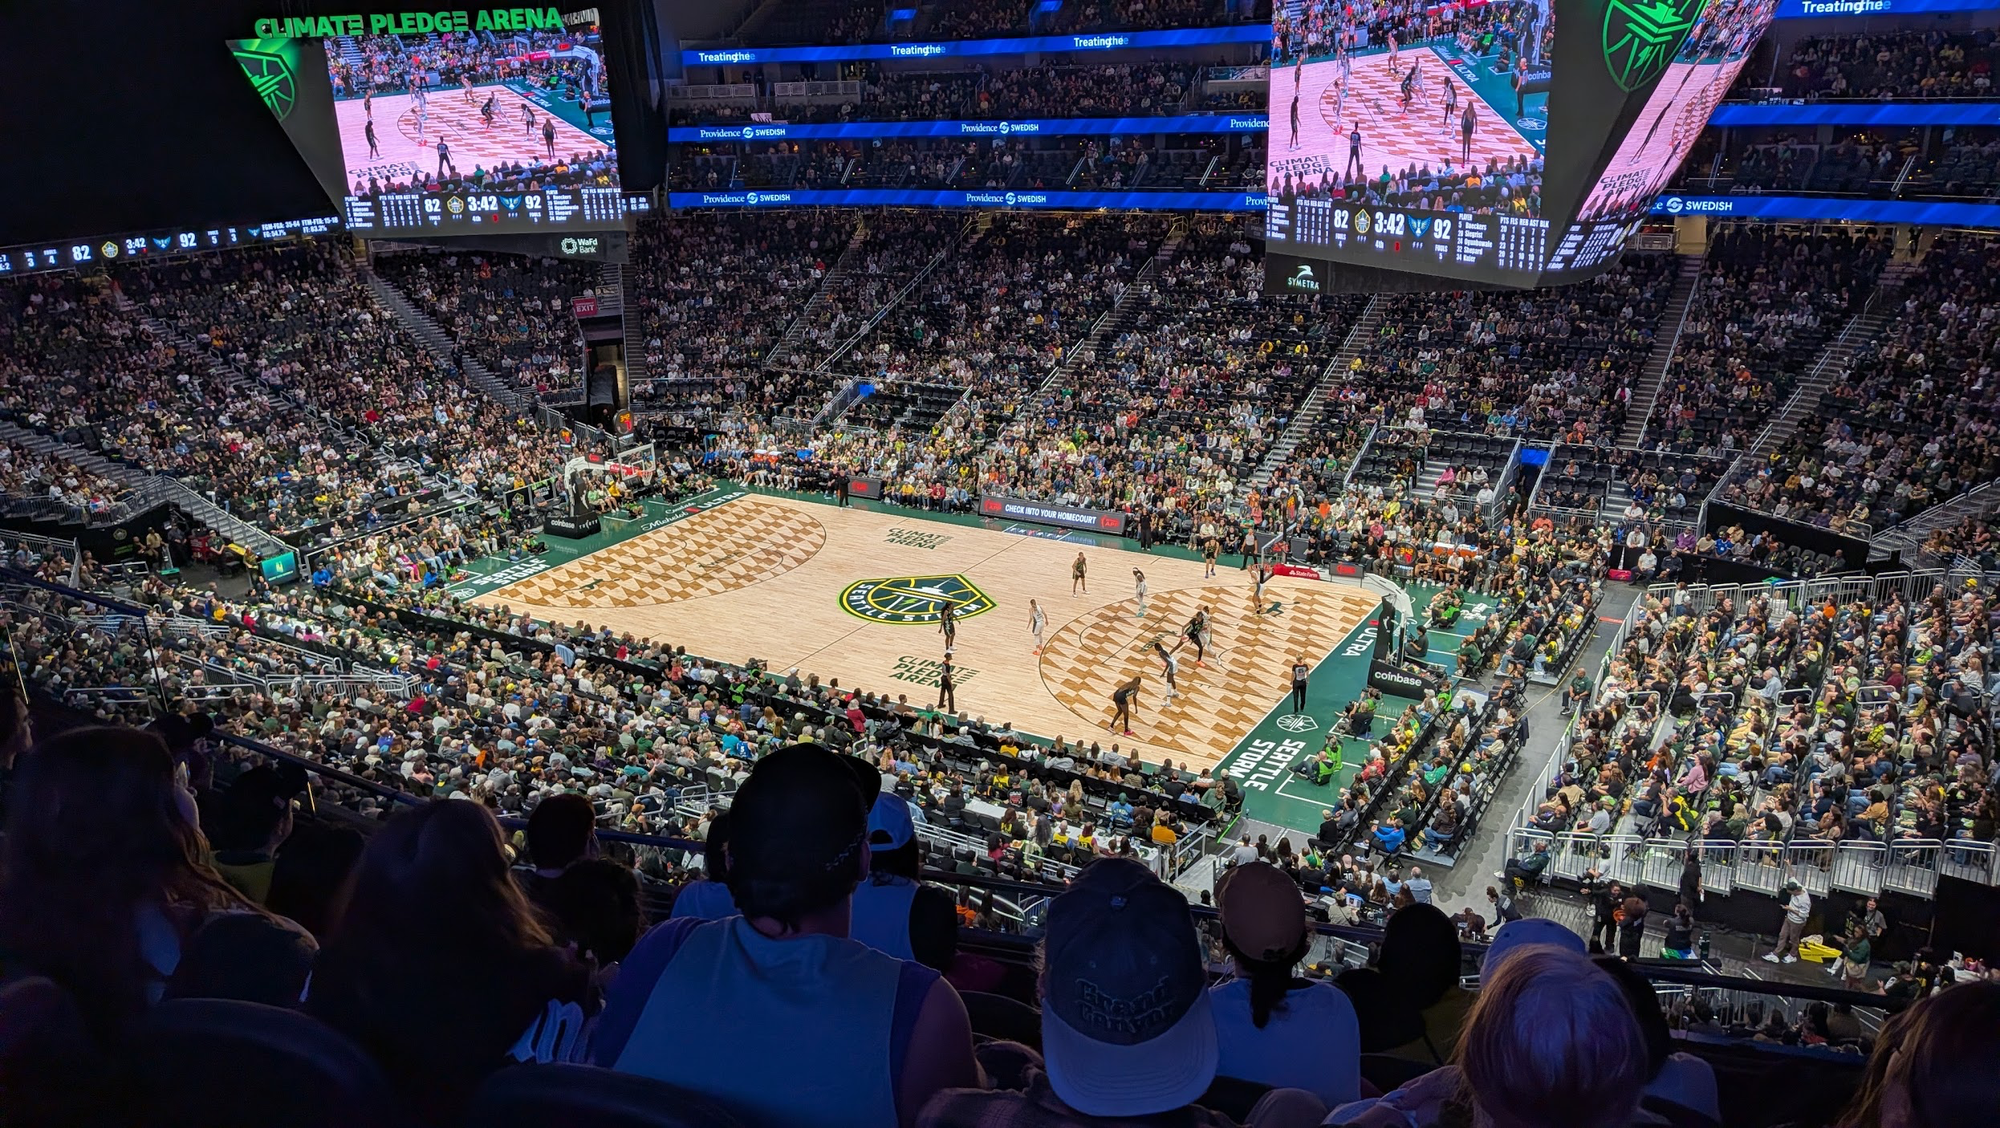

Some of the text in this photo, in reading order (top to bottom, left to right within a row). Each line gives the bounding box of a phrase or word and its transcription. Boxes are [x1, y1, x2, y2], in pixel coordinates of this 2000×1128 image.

[255, 14, 364, 39] CLIMATE
[370, 11, 468, 34] PLEDGE
[476, 7, 564, 31] ARENA
[700, 129, 741, 138] Providence
[961, 123, 998, 132] Providence
[467, 196, 498, 211] 3:42
[525, 195, 542, 209] 92
[703, 194, 791, 203] Providence SWEDISH
[966, 193, 1047, 203] Providence SWEDISH
[424, 199, 441, 212] 82
[1685, 201, 1733, 211] SWEDISH
[1334, 209, 1348, 229] 82
[1374, 212, 1404, 235] 3:42
[1500, 216, 1509, 224] PTS
[1510, 217, 1518, 225] FLS
[1519, 218, 1528, 226] REB
[1529, 219, 1538, 227] AST
[1539, 220, 1549, 228] BLK
[1433, 218, 1451, 240] 92
[127, 237, 147, 249] 3:42
[180, 233, 197, 248] 92
[212, 236, 218, 244] 5
[231, 233, 237, 242] 3
[577, 238, 598, 246] WaFd
[579, 246, 597, 254] Bank
[1375, 240, 1384, 249] 4th
[1434, 244, 1448, 252] FOULS
[73, 245, 92, 261] 82
[28, 258, 35, 267] 3
[49, 256, 56, 264] 4
[1287, 276, 1320, 290] SYMETRA
[576, 304, 594, 312] EXIT
[697, 491, 746, 509] ULTRA
[1005, 504, 1025, 514] CHECK
[1040, 509, 1057, 519] YOUR
[1057, 512, 1096, 524] HOMECOURT
[550, 519, 575, 529] coinbase
[882, 538, 936, 550] ARENA
[472, 558, 547, 585] SEATTLE
[494, 563, 551, 585] STORM
[849, 583, 983, 622] SEATTLE STRM
[1341, 627, 1378, 656] ULTRA
[888, 672, 957, 692] AREN
[1374, 671, 1422, 687] coinbase
[1228, 738, 1276, 779] STORM
[1242, 738, 1306, 791] SEATTLE
